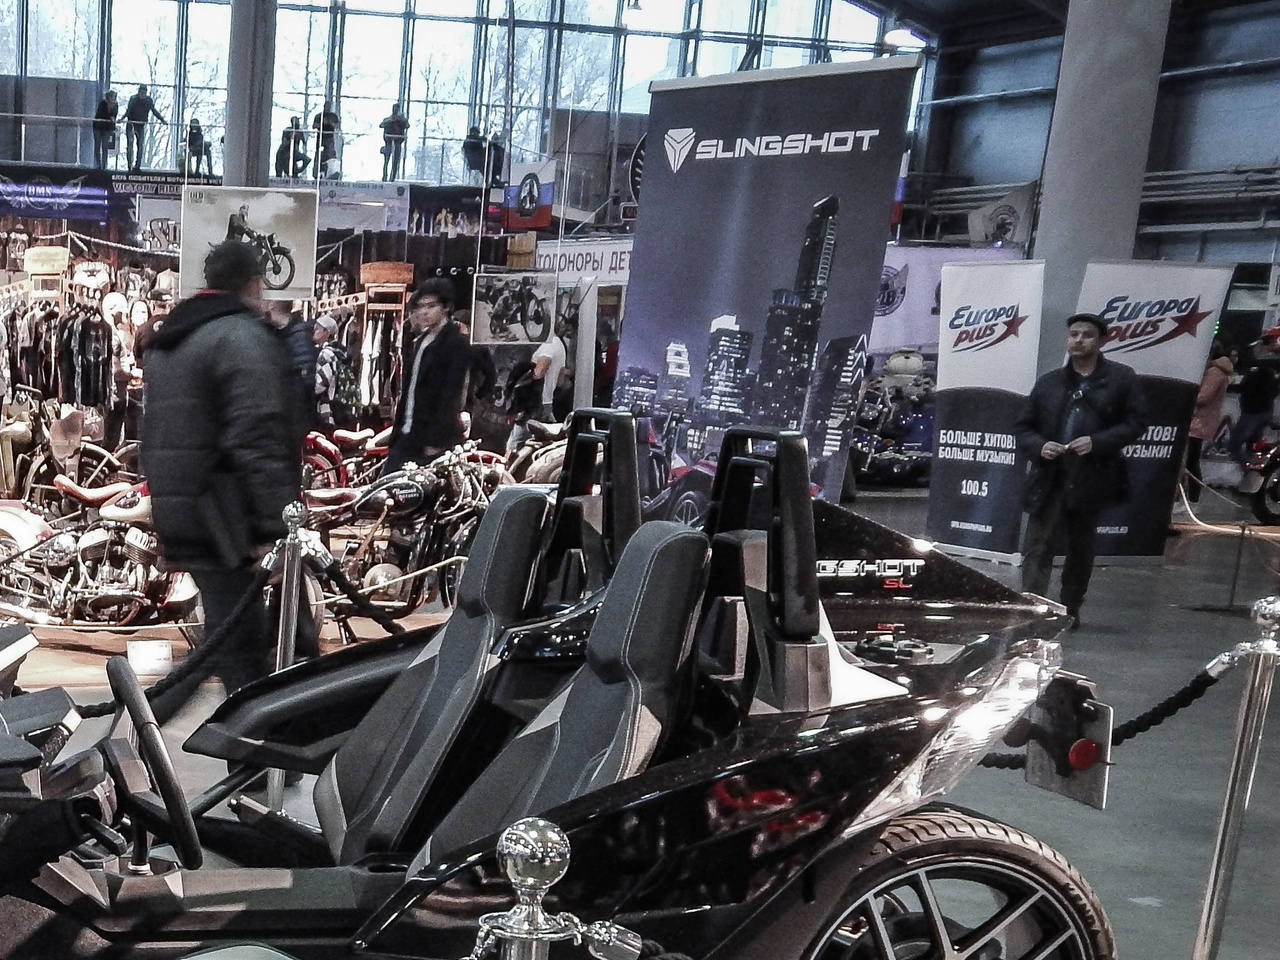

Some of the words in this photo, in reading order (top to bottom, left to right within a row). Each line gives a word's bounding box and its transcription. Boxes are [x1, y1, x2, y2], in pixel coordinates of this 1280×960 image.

[695, 129, 880, 161] SLINGSHOT
[112, 182, 157, 194] VICTORY
[158, 183, 183, 195] RIDE
[939, 429, 982, 446] БОЛЬШЕ
[983, 432, 1016, 449] ХИТОВ!
[1141, 425, 1178, 442] ТОВ!
[938, 446, 975, 461] БОЛЬШЕ
[976, 449, 1016, 466] МУЗЫКИ!
[961, 479, 989, 497] 100.5
[816, 559, 926, 578] GSHOT
[883, 577, 913, 589] SL
